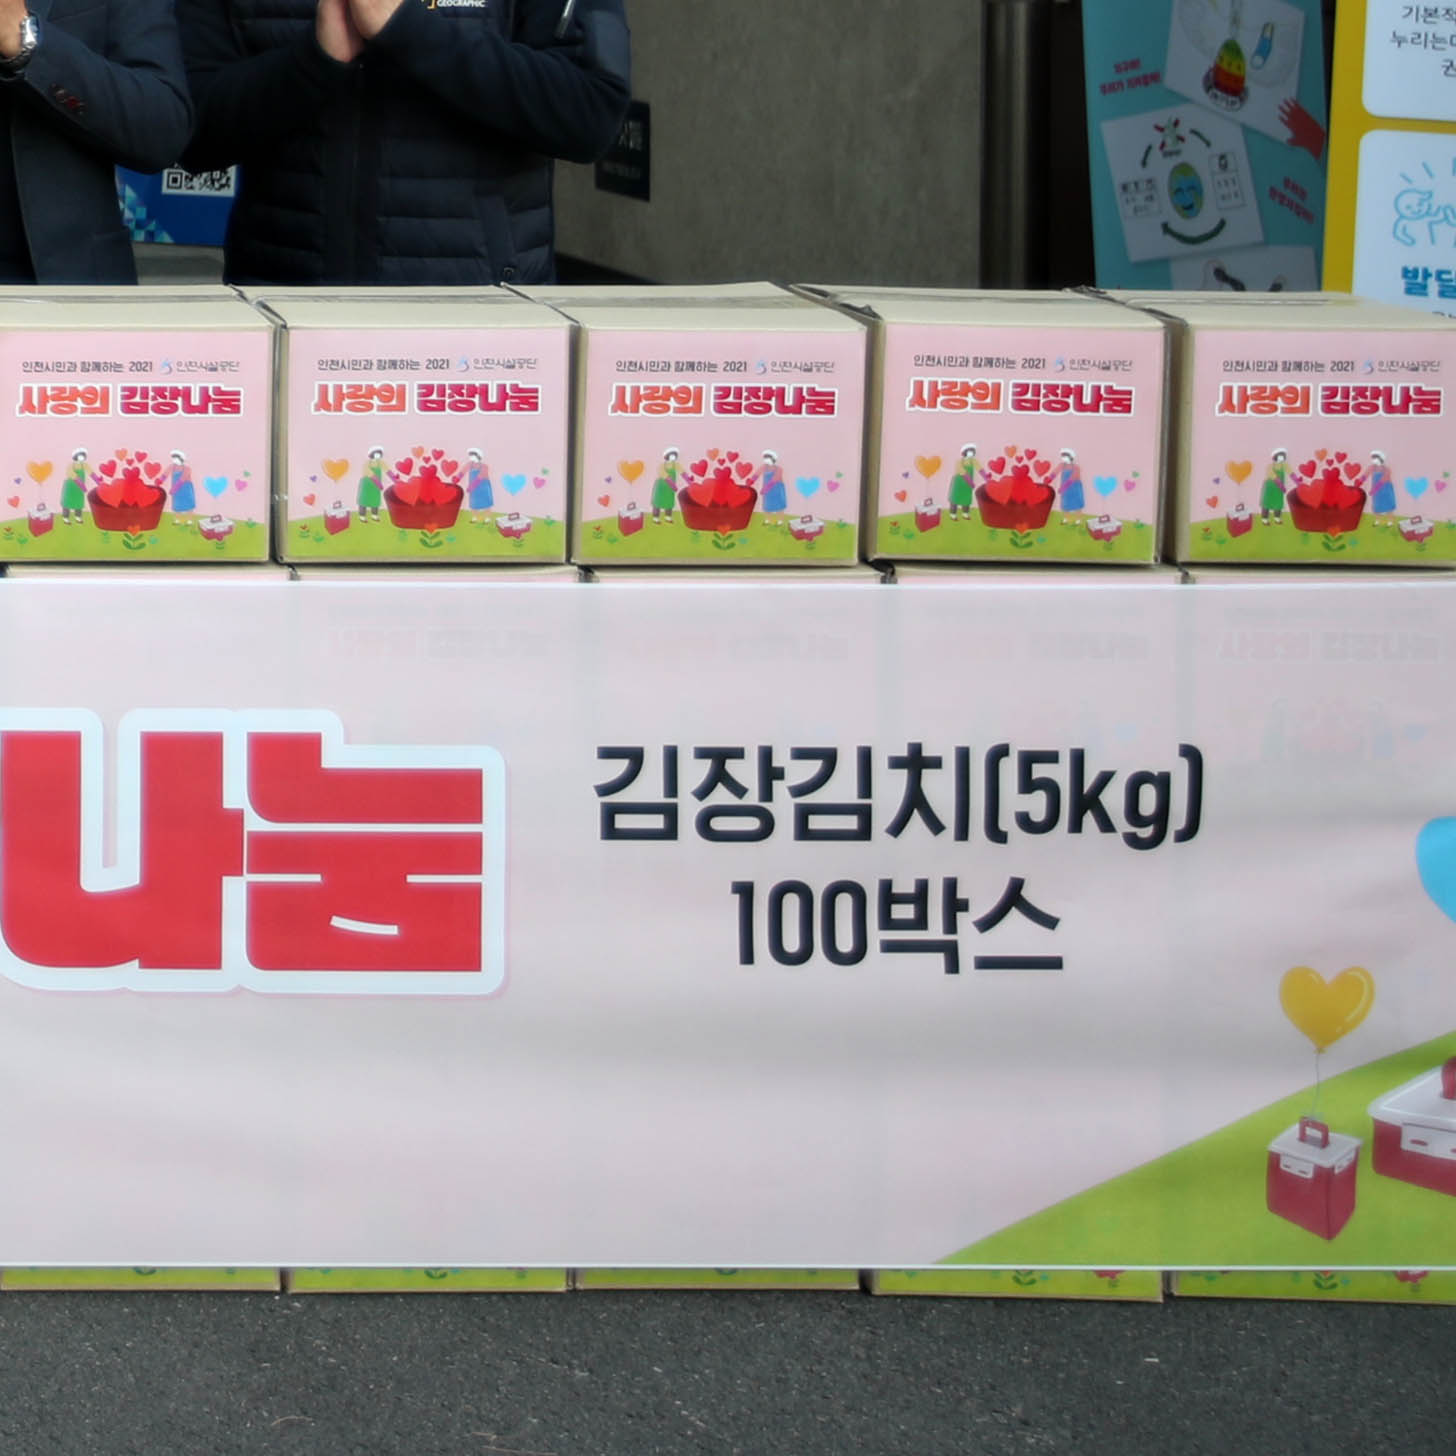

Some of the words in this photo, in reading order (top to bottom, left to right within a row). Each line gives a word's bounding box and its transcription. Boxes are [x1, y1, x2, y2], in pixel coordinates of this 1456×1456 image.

[21, 360, 78, 374] 인천시민과
[80, 360, 125, 373] 함께하는
[128, 360, 153, 373] 2021
[317, 358, 374, 372] 인천시민과
[376, 358, 421, 372] 함께하는
[424, 358, 450, 371] 2021
[615, 360, 673, 373] 인천시민과
[675, 360, 719, 373] 함께하는
[722, 360, 748, 373] 2021
[913, 354, 969, 369] 인천시민과
[971, 356, 1017, 370] 함께하는
[1020, 357, 1047, 370] 2021
[1222, 359, 1279, 373] 인천시민과
[1281, 360, 1326, 373] 함께하는
[1329, 360, 1355, 373] 2021
[19, 385, 111, 415] 사랑의
[120, 386, 242, 415] 김장나눔
[315, 382, 407, 413] 사랑의
[417, 383, 539, 413] 김장나눔
[612, 385, 703, 415] 사랑의
[714, 386, 837, 416] 김장나눔
[911, 380, 1002, 411] 사랑의
[1012, 382, 1134, 415] 김장나눔
[1220, 384, 1312, 415] 사랑의
[1321, 385, 1443, 416] 김장나눔
[593, 742, 1204, 852] 김장김치(5kg)
[731, 876, 1065, 975] 100박스
